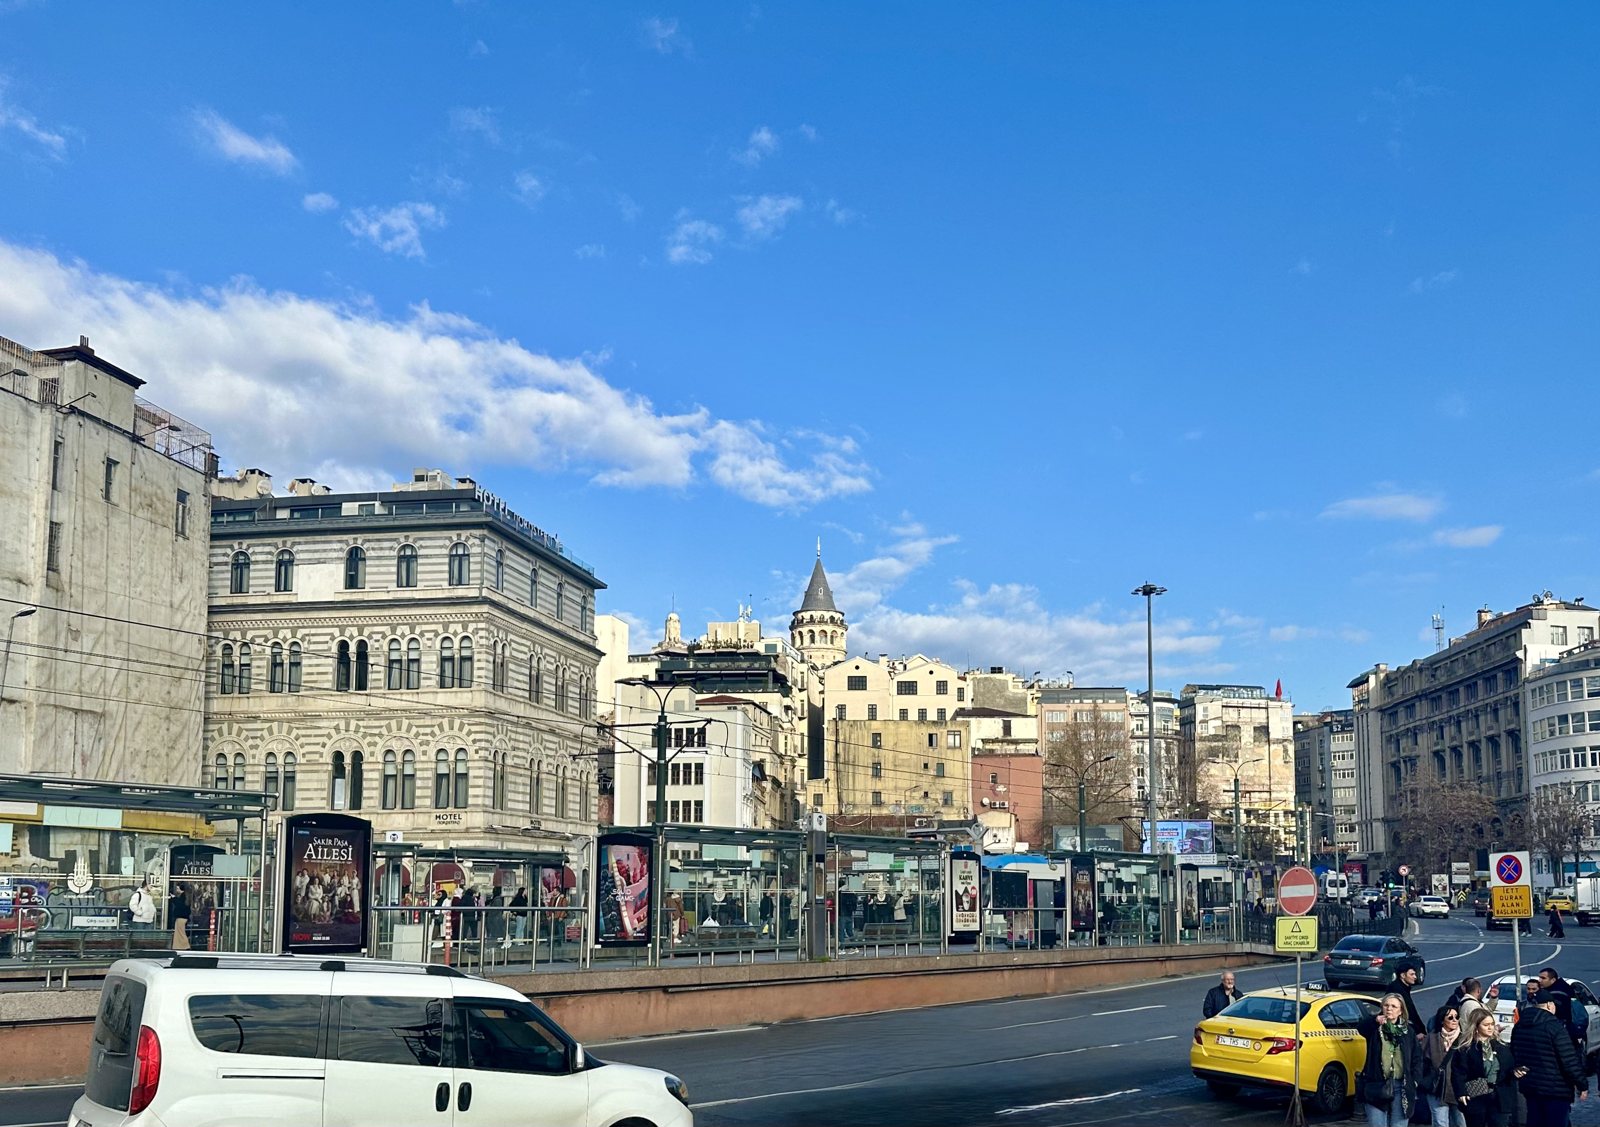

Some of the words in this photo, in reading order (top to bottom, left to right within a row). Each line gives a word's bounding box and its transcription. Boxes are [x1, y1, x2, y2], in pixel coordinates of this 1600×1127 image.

[475, 485, 511, 519] HOTEL
[435, 813, 462, 821] HOTEL
[313, 837, 333, 847] ŞAKİR
[334, 838, 348, 848] PAŞA
[303, 843, 352, 861] AİLESİ
